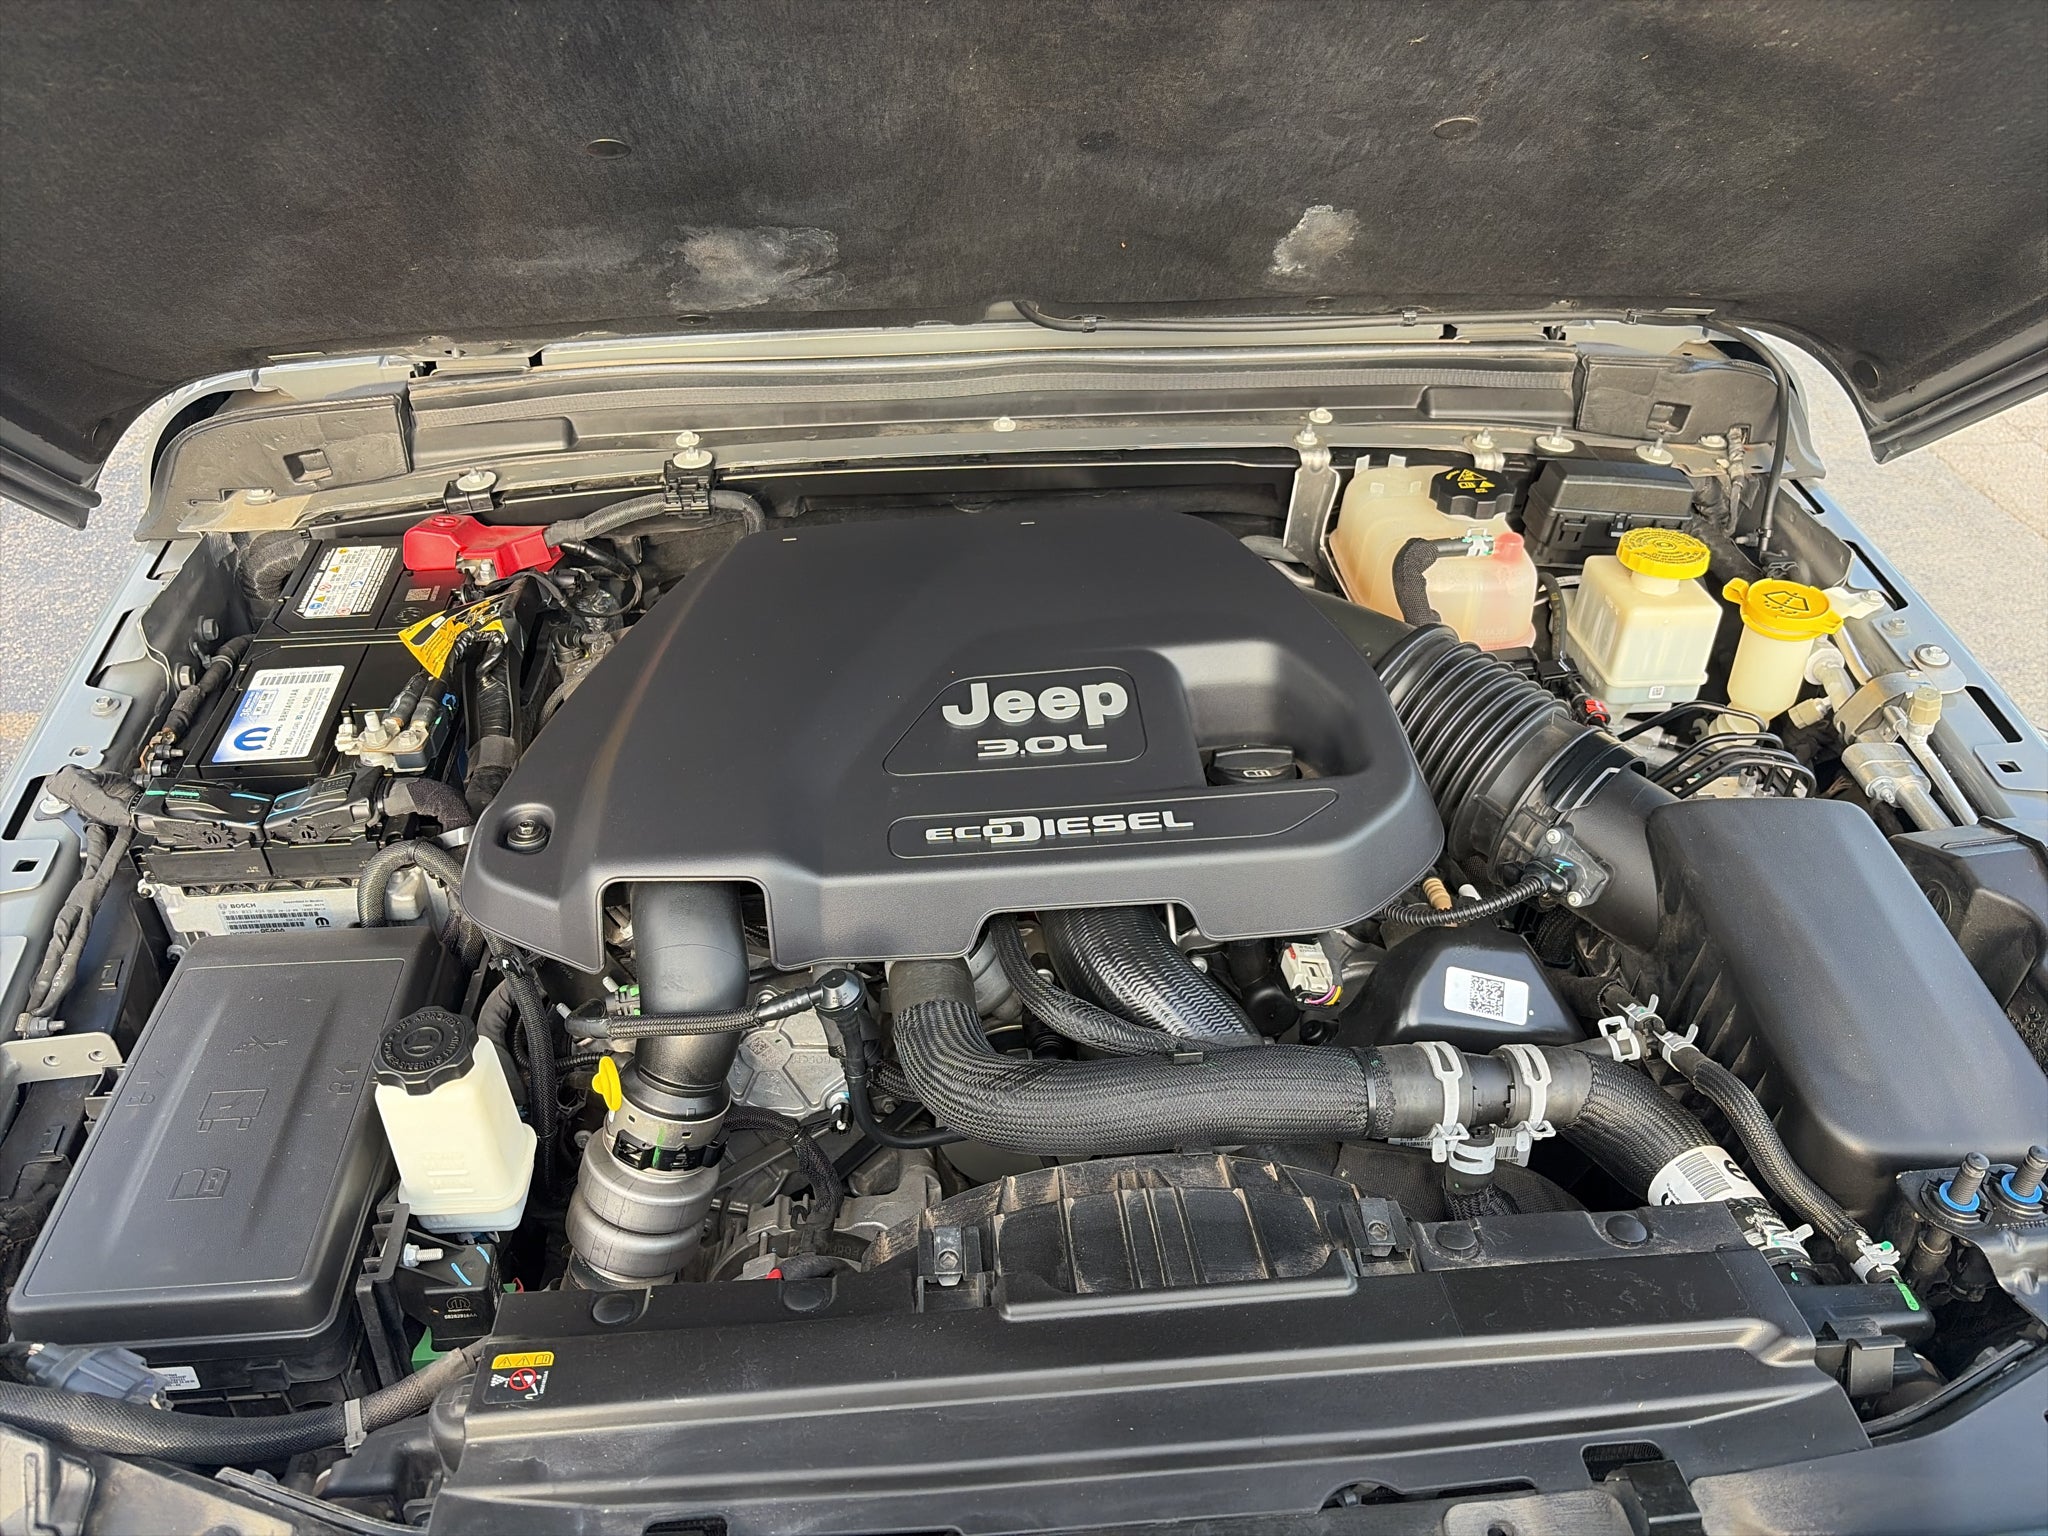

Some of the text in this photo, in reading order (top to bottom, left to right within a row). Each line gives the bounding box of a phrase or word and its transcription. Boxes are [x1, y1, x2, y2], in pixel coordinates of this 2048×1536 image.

[942, 682, 1128, 727] Jeep
[977, 734, 1107, 757] 3.0L
[394, 1010, 457, 1032] USE APPROVED
